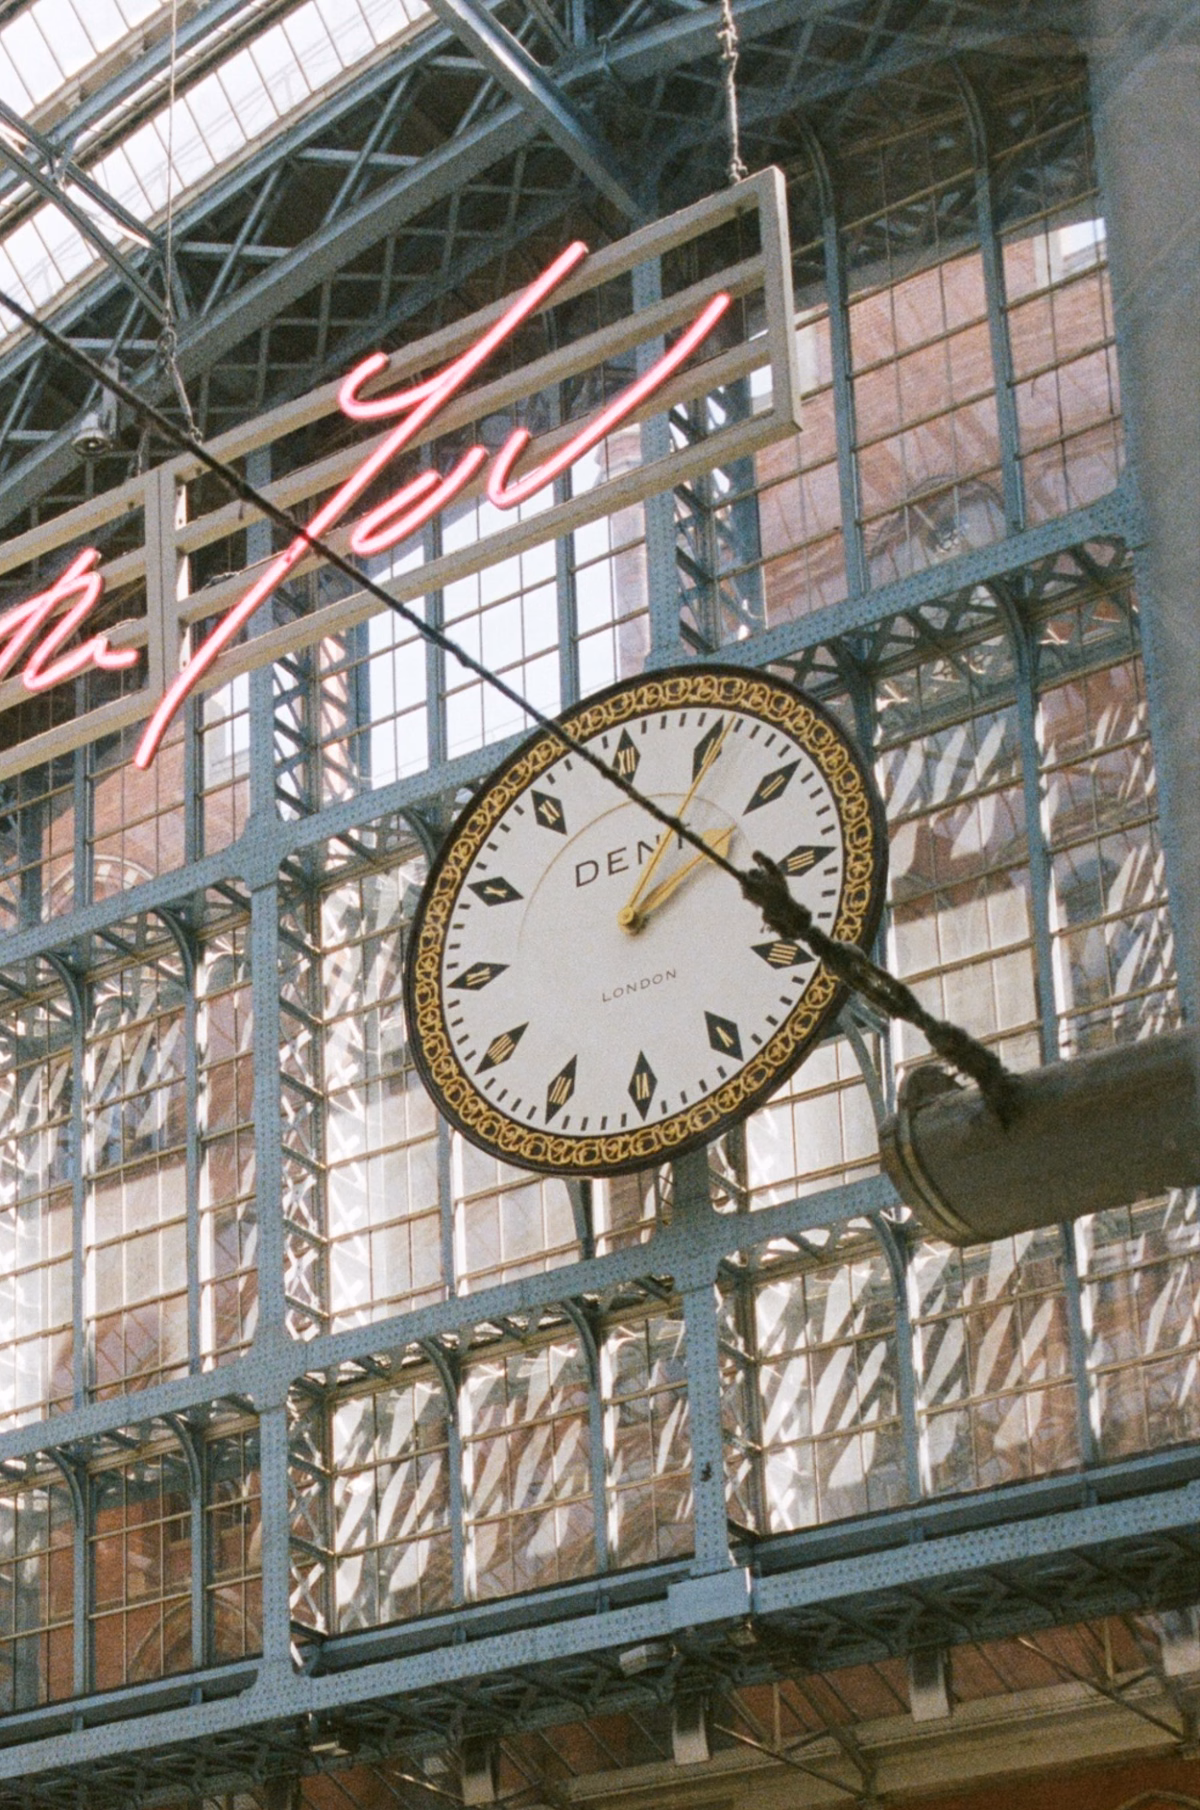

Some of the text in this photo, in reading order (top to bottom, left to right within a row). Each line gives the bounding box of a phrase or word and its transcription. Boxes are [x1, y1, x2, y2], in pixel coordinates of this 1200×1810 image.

[759, 774, 786, 800] II
[787, 849, 815, 873] III
[483, 885, 508, 899] X
[602, 968, 678, 1003] LONDON
[715, 1025, 735, 1048] V
